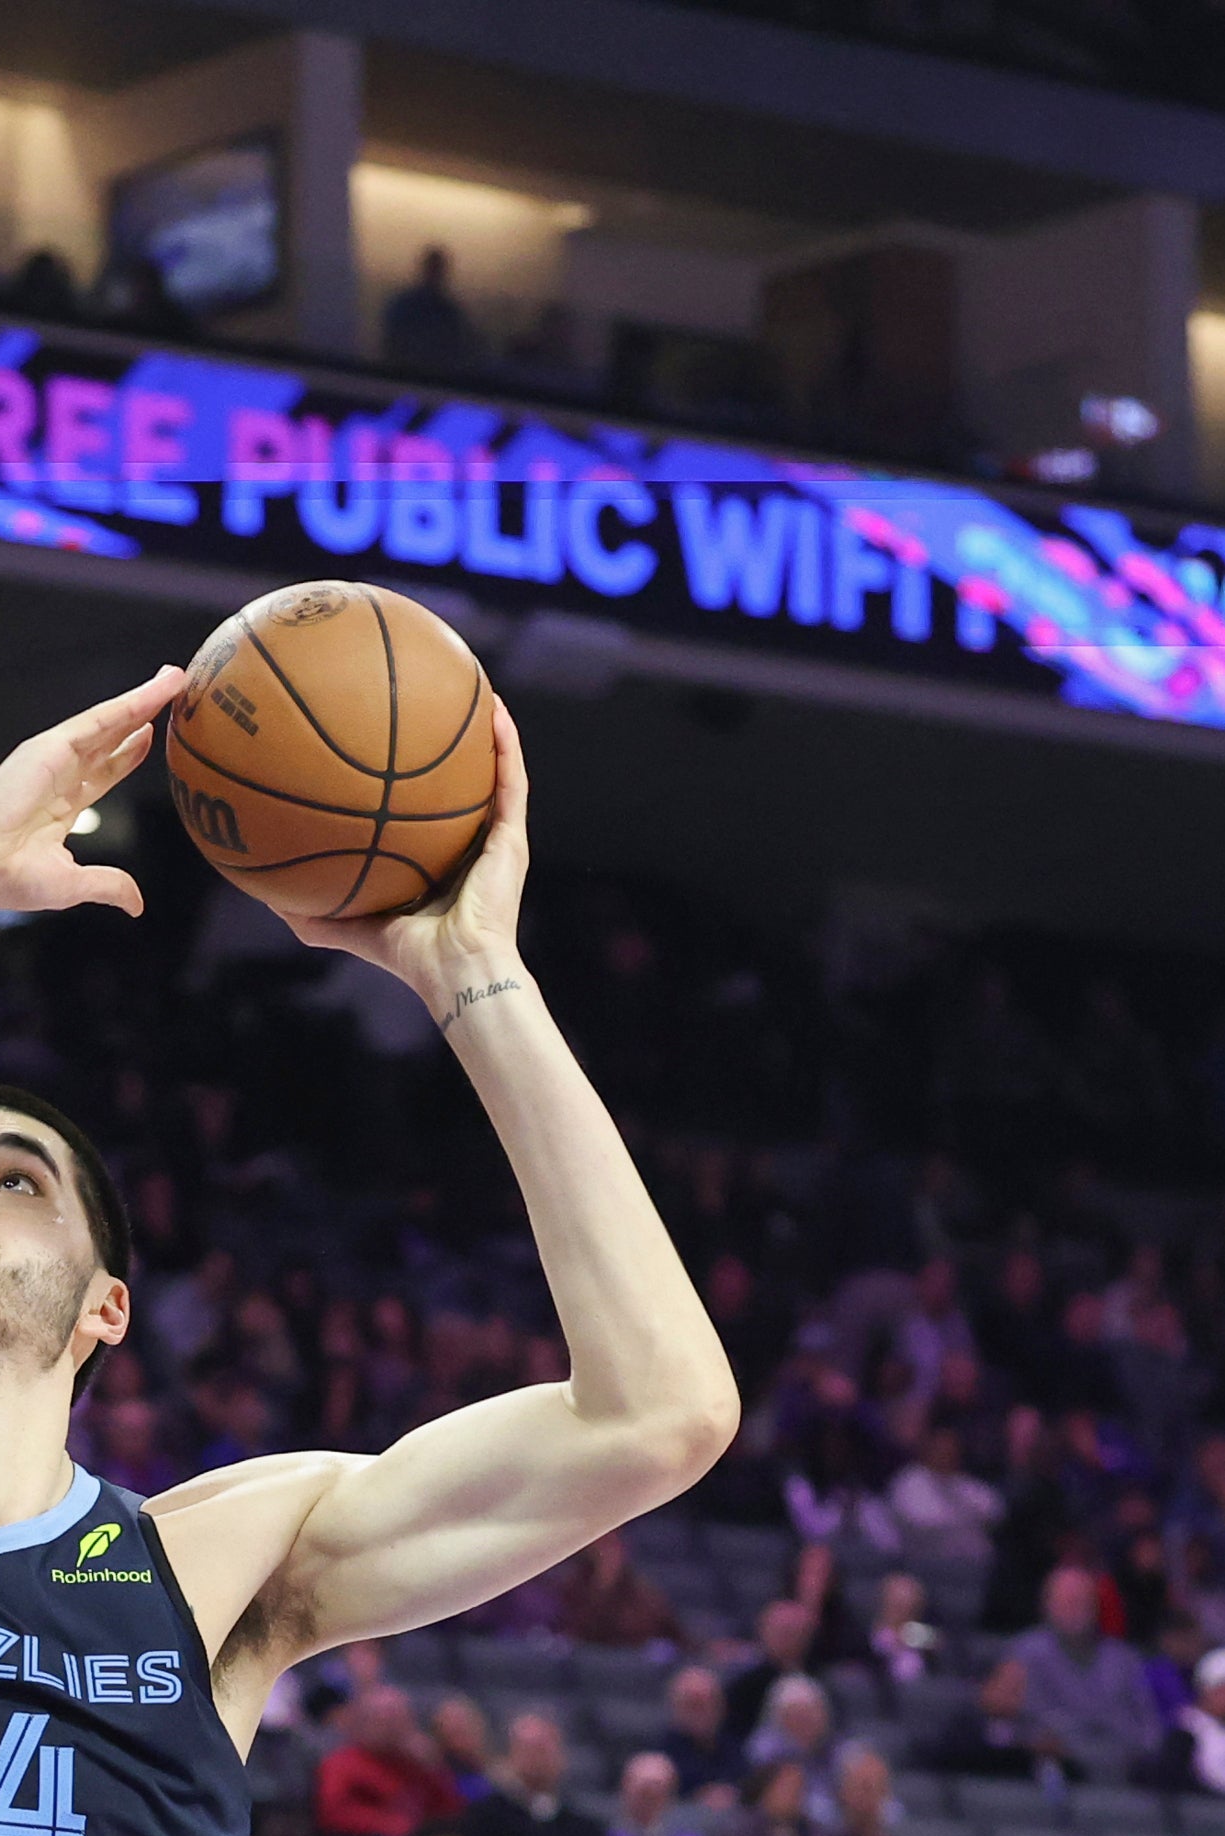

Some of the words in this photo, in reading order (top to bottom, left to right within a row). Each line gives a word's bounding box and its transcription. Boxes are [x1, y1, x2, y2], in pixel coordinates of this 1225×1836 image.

[220, 406, 658, 598] PUBLIC
[671, 481, 933, 642] WIFI
[51, 1567, 152, 1584] Robinhood
